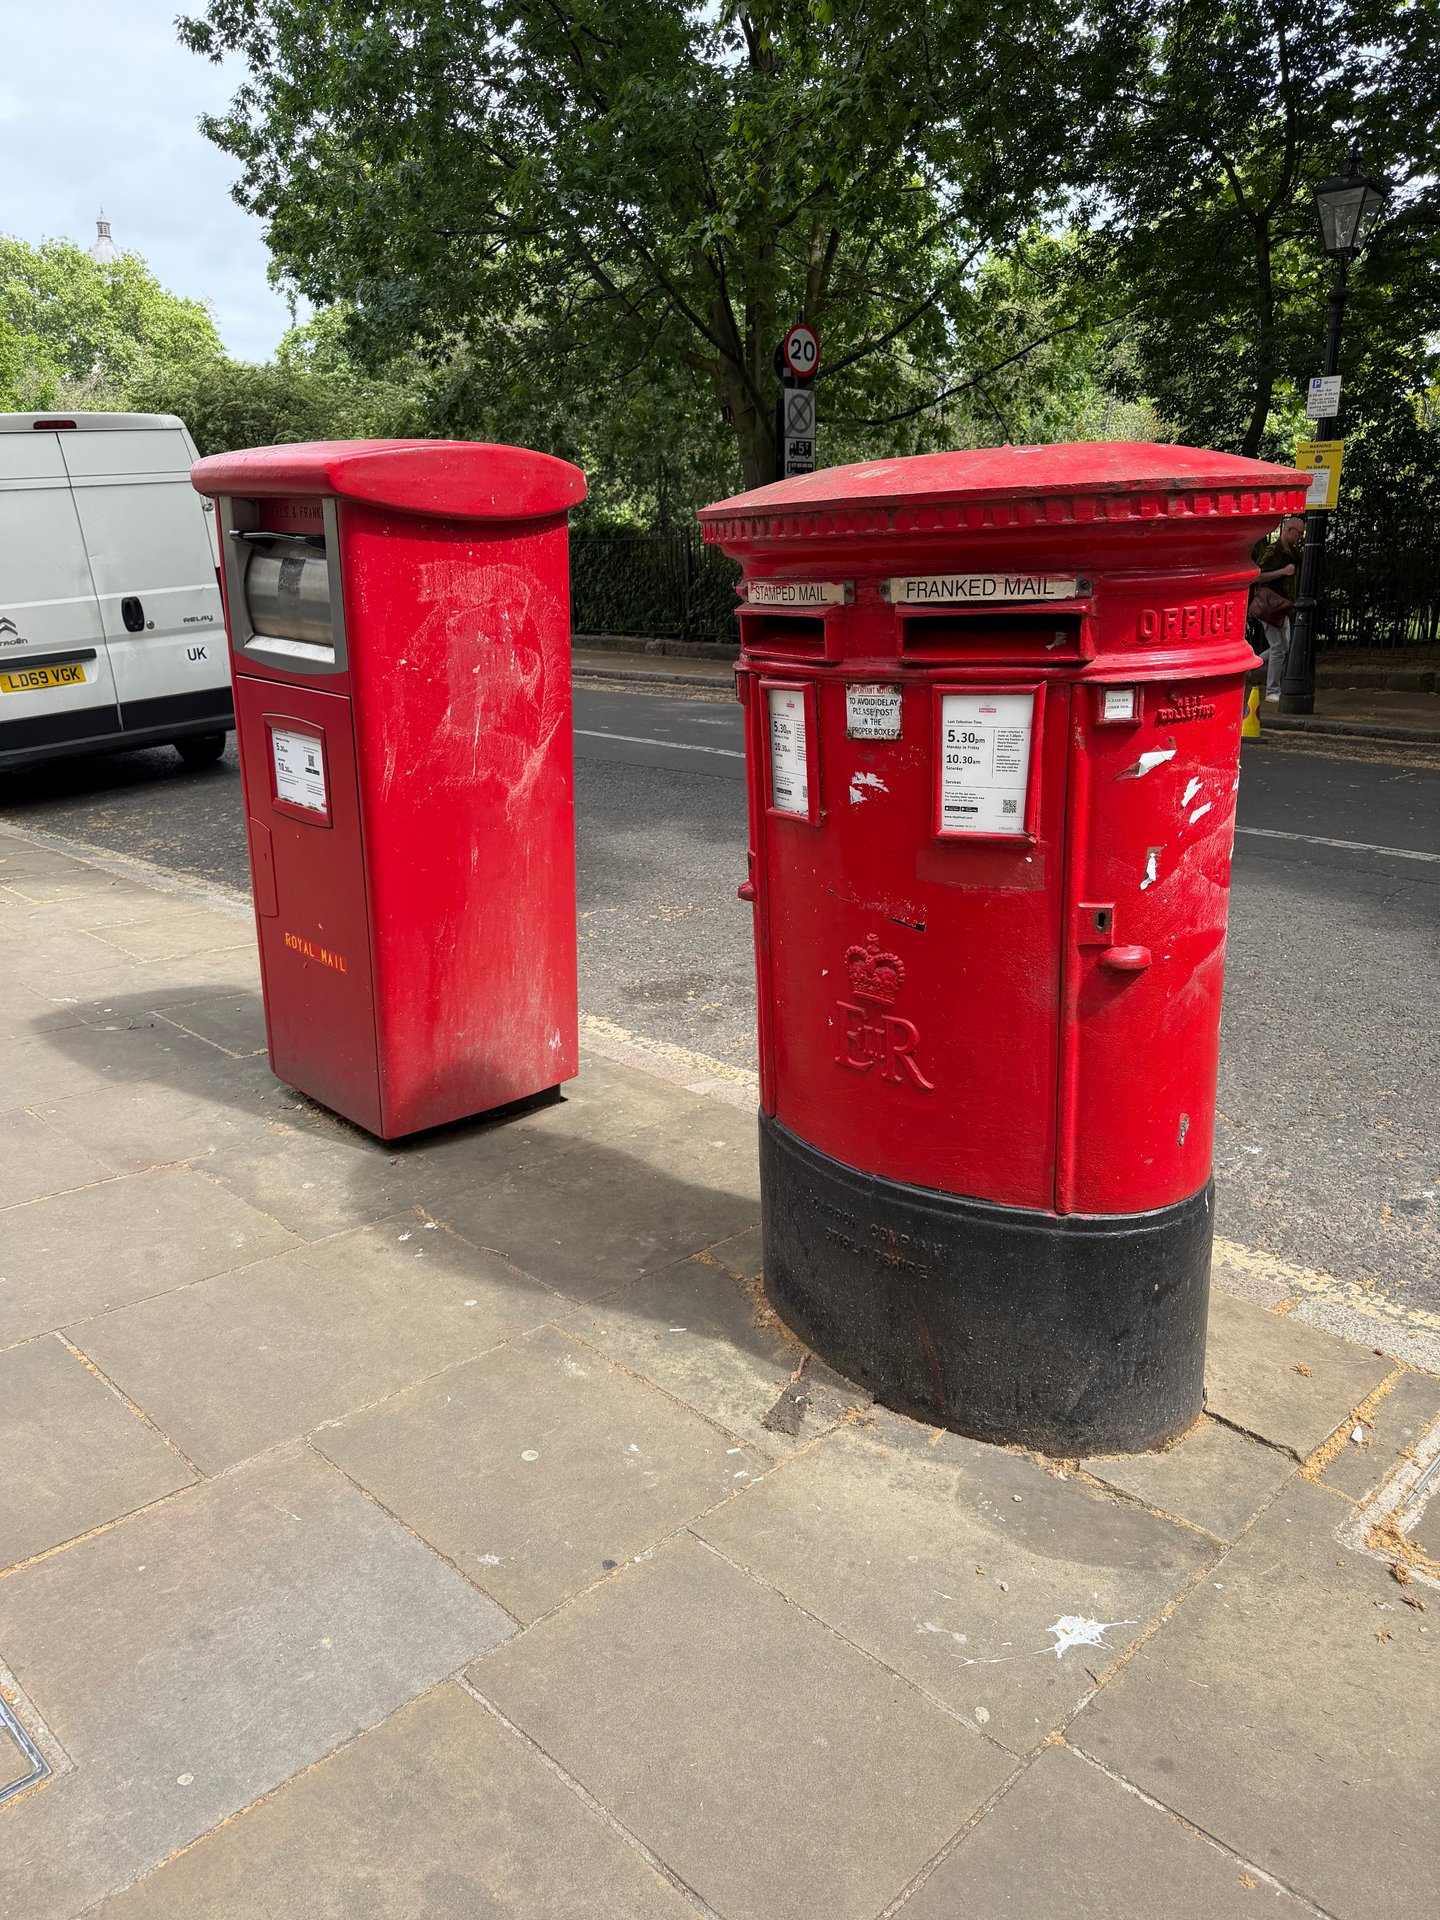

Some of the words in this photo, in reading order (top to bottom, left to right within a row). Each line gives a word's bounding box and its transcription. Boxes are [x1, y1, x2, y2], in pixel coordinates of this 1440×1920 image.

[790, 338, 816, 362] 20
[755, 585, 796, 601] STAMPED
[798, 585, 828, 601] MAIL
[906, 578, 997, 599] FRANKED
[1004, 577, 1055, 597] MAIL
[182, 615, 214, 623] RELAY
[1138, 601, 1235, 641] OFFICE
[186, 646, 208, 661] UK
[7, 671, 49, 689] LD69
[51, 667, 81, 683] VGK
[848, 697, 856, 705] TO
[857, 698, 876, 706] AVOID
[877, 699, 899, 707] DELAY
[1176, 695, 1205, 707] NEXT
[852, 707, 874, 716] PLEASE
[875, 708, 894, 717] POST
[870, 718, 882, 726] THE
[851, 726, 873, 736] PROPER
[873, 727, 897, 737] BOXES
[947, 729, 986, 744] 5.30pm
[945, 754, 981, 765] 10.30am
[285, 932, 315, 957] ROYAL
[321, 948, 346, 973] MAIL
